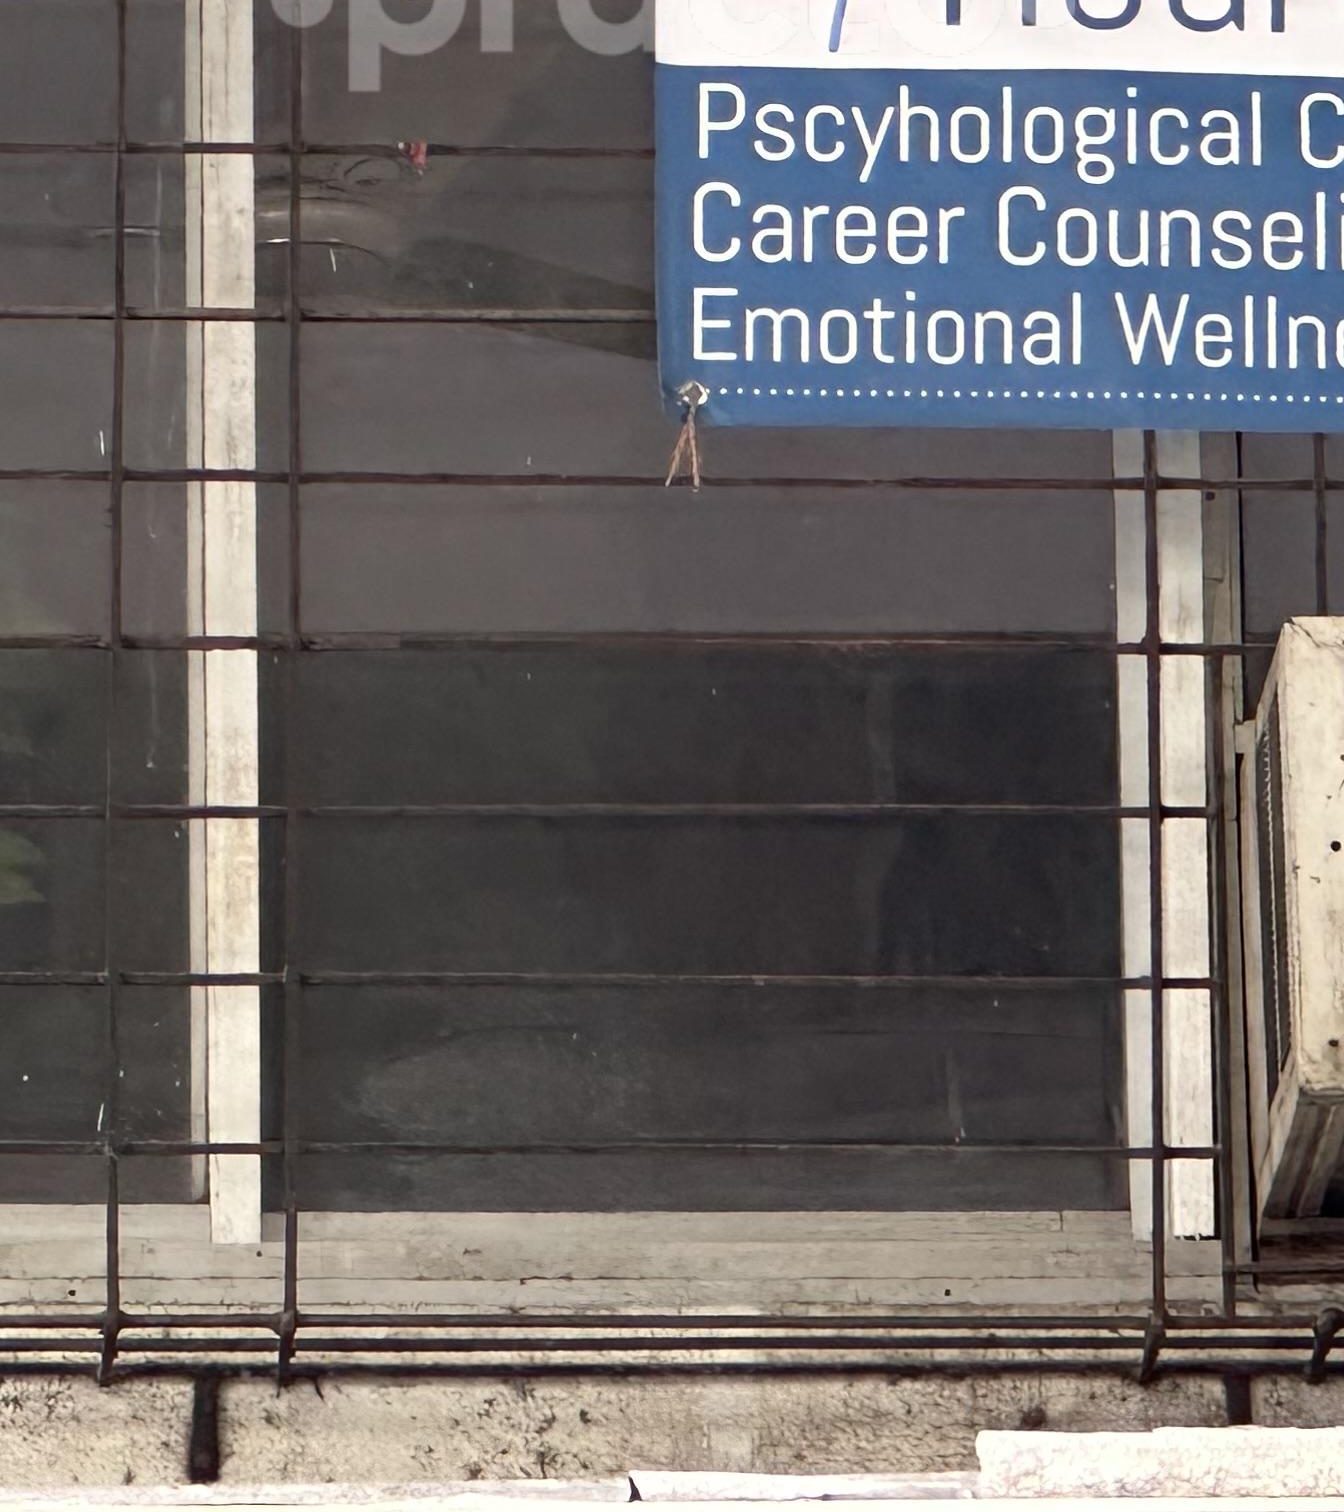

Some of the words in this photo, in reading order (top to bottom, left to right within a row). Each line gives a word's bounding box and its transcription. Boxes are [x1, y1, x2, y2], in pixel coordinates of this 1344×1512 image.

[698, 82, 1262, 185] Pscyhological
[693, 181, 966, 265] Career
[692, 287, 1082, 366] Emotional
